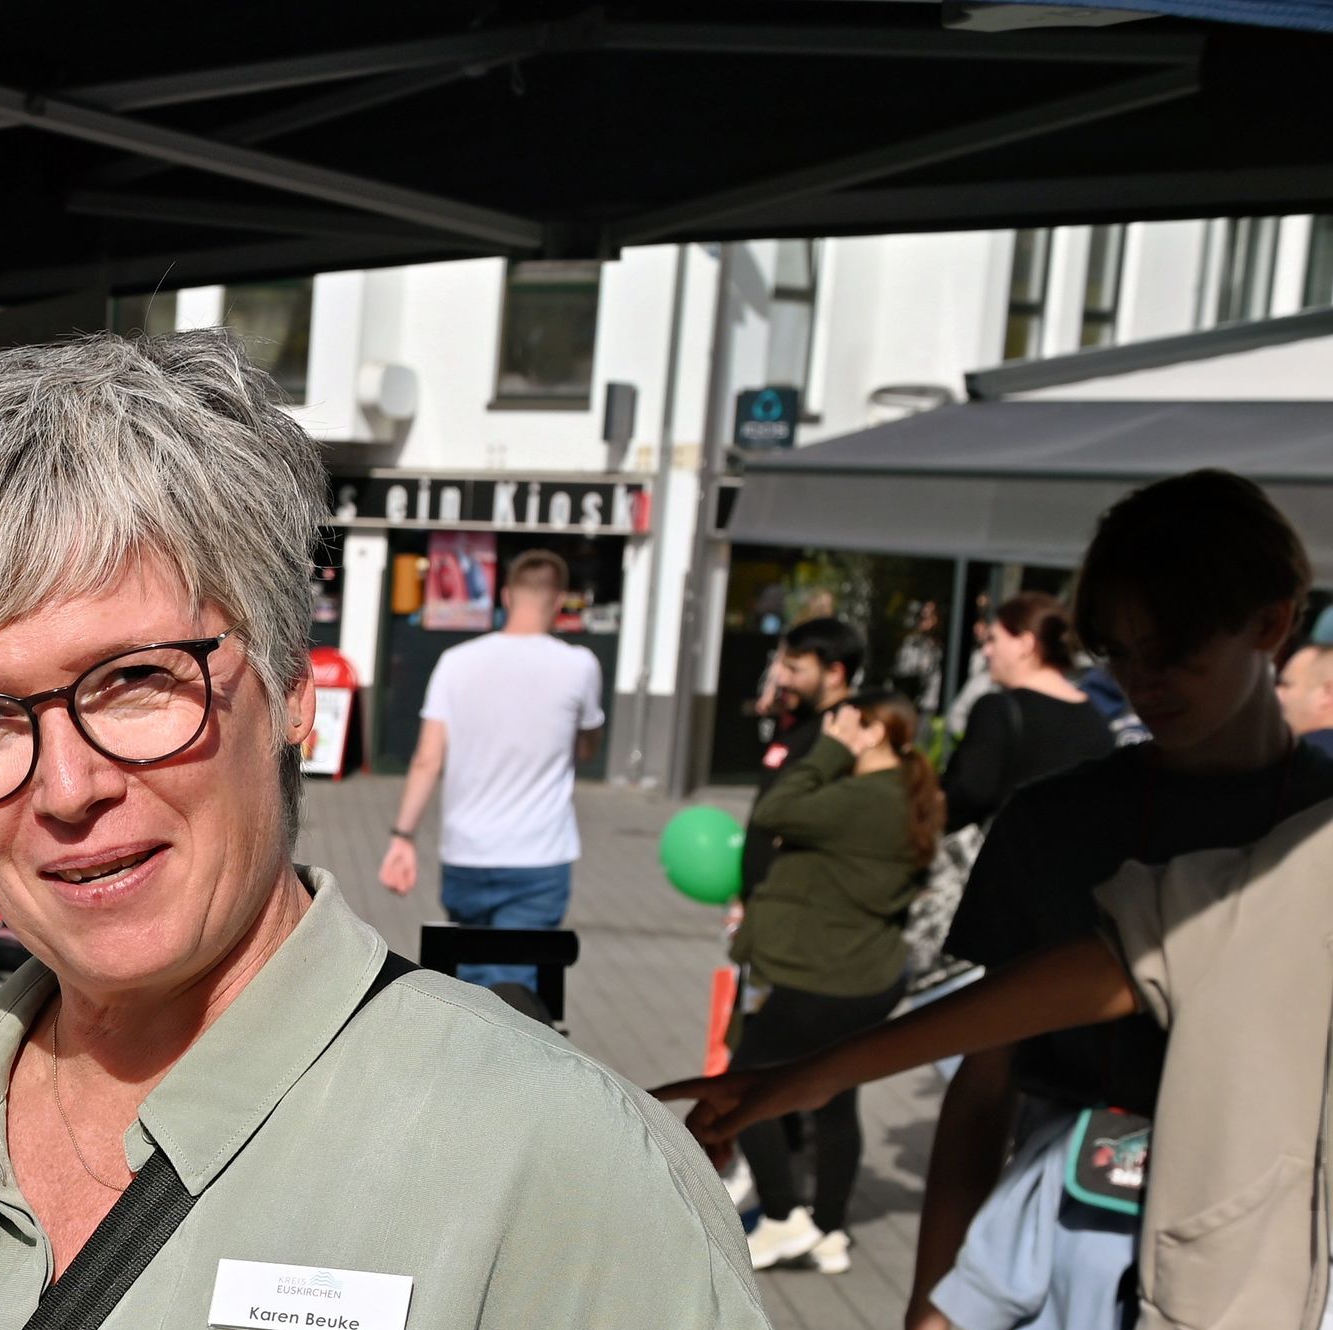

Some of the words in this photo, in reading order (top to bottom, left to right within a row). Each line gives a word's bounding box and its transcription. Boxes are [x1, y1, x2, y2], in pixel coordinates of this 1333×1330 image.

[386, 476, 461, 524] ein
[492, 480, 633, 531] Kiosk
[278, 1276, 307, 1285] KREIS
[276, 1284, 342, 1299] EUSKIRCHEN
[249, 1306, 300, 1324] Karen
[305, 1312, 360, 1330] Beuke
